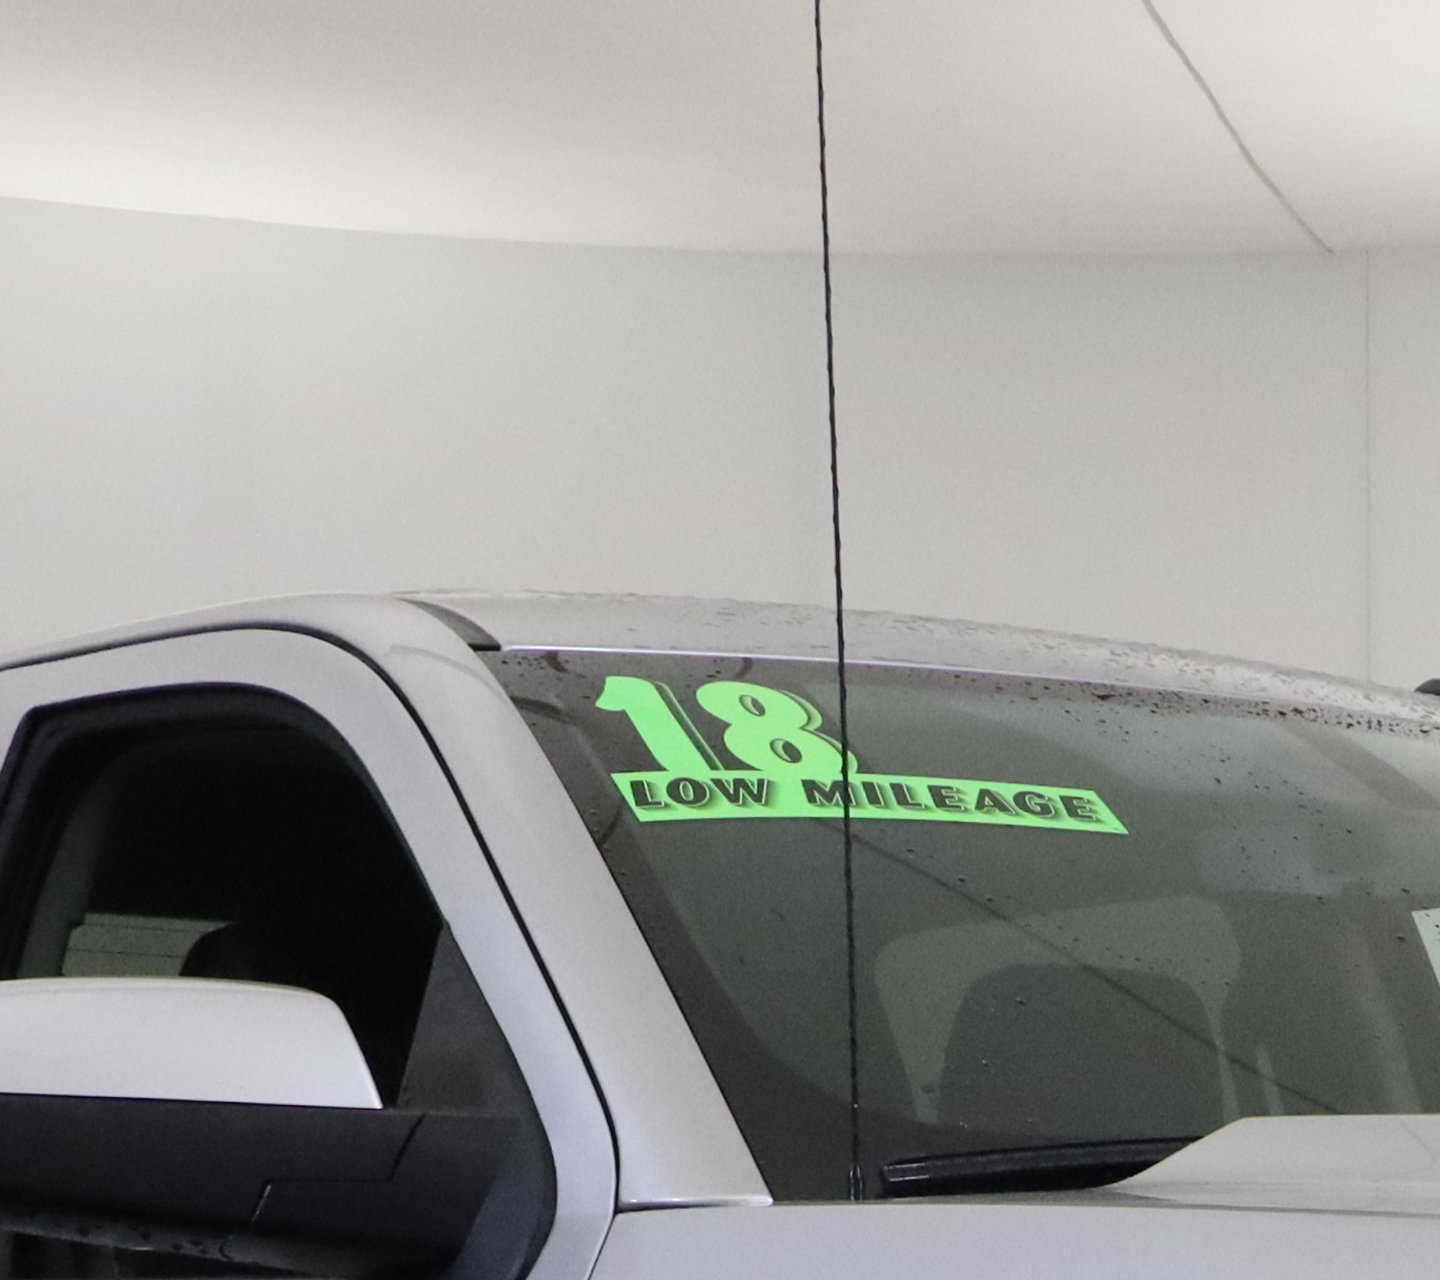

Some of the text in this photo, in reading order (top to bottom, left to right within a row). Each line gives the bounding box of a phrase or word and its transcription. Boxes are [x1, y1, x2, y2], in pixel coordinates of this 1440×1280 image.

[594, 675, 858, 775] 18
[629, 776, 1102, 823] LOW MILEAGE
